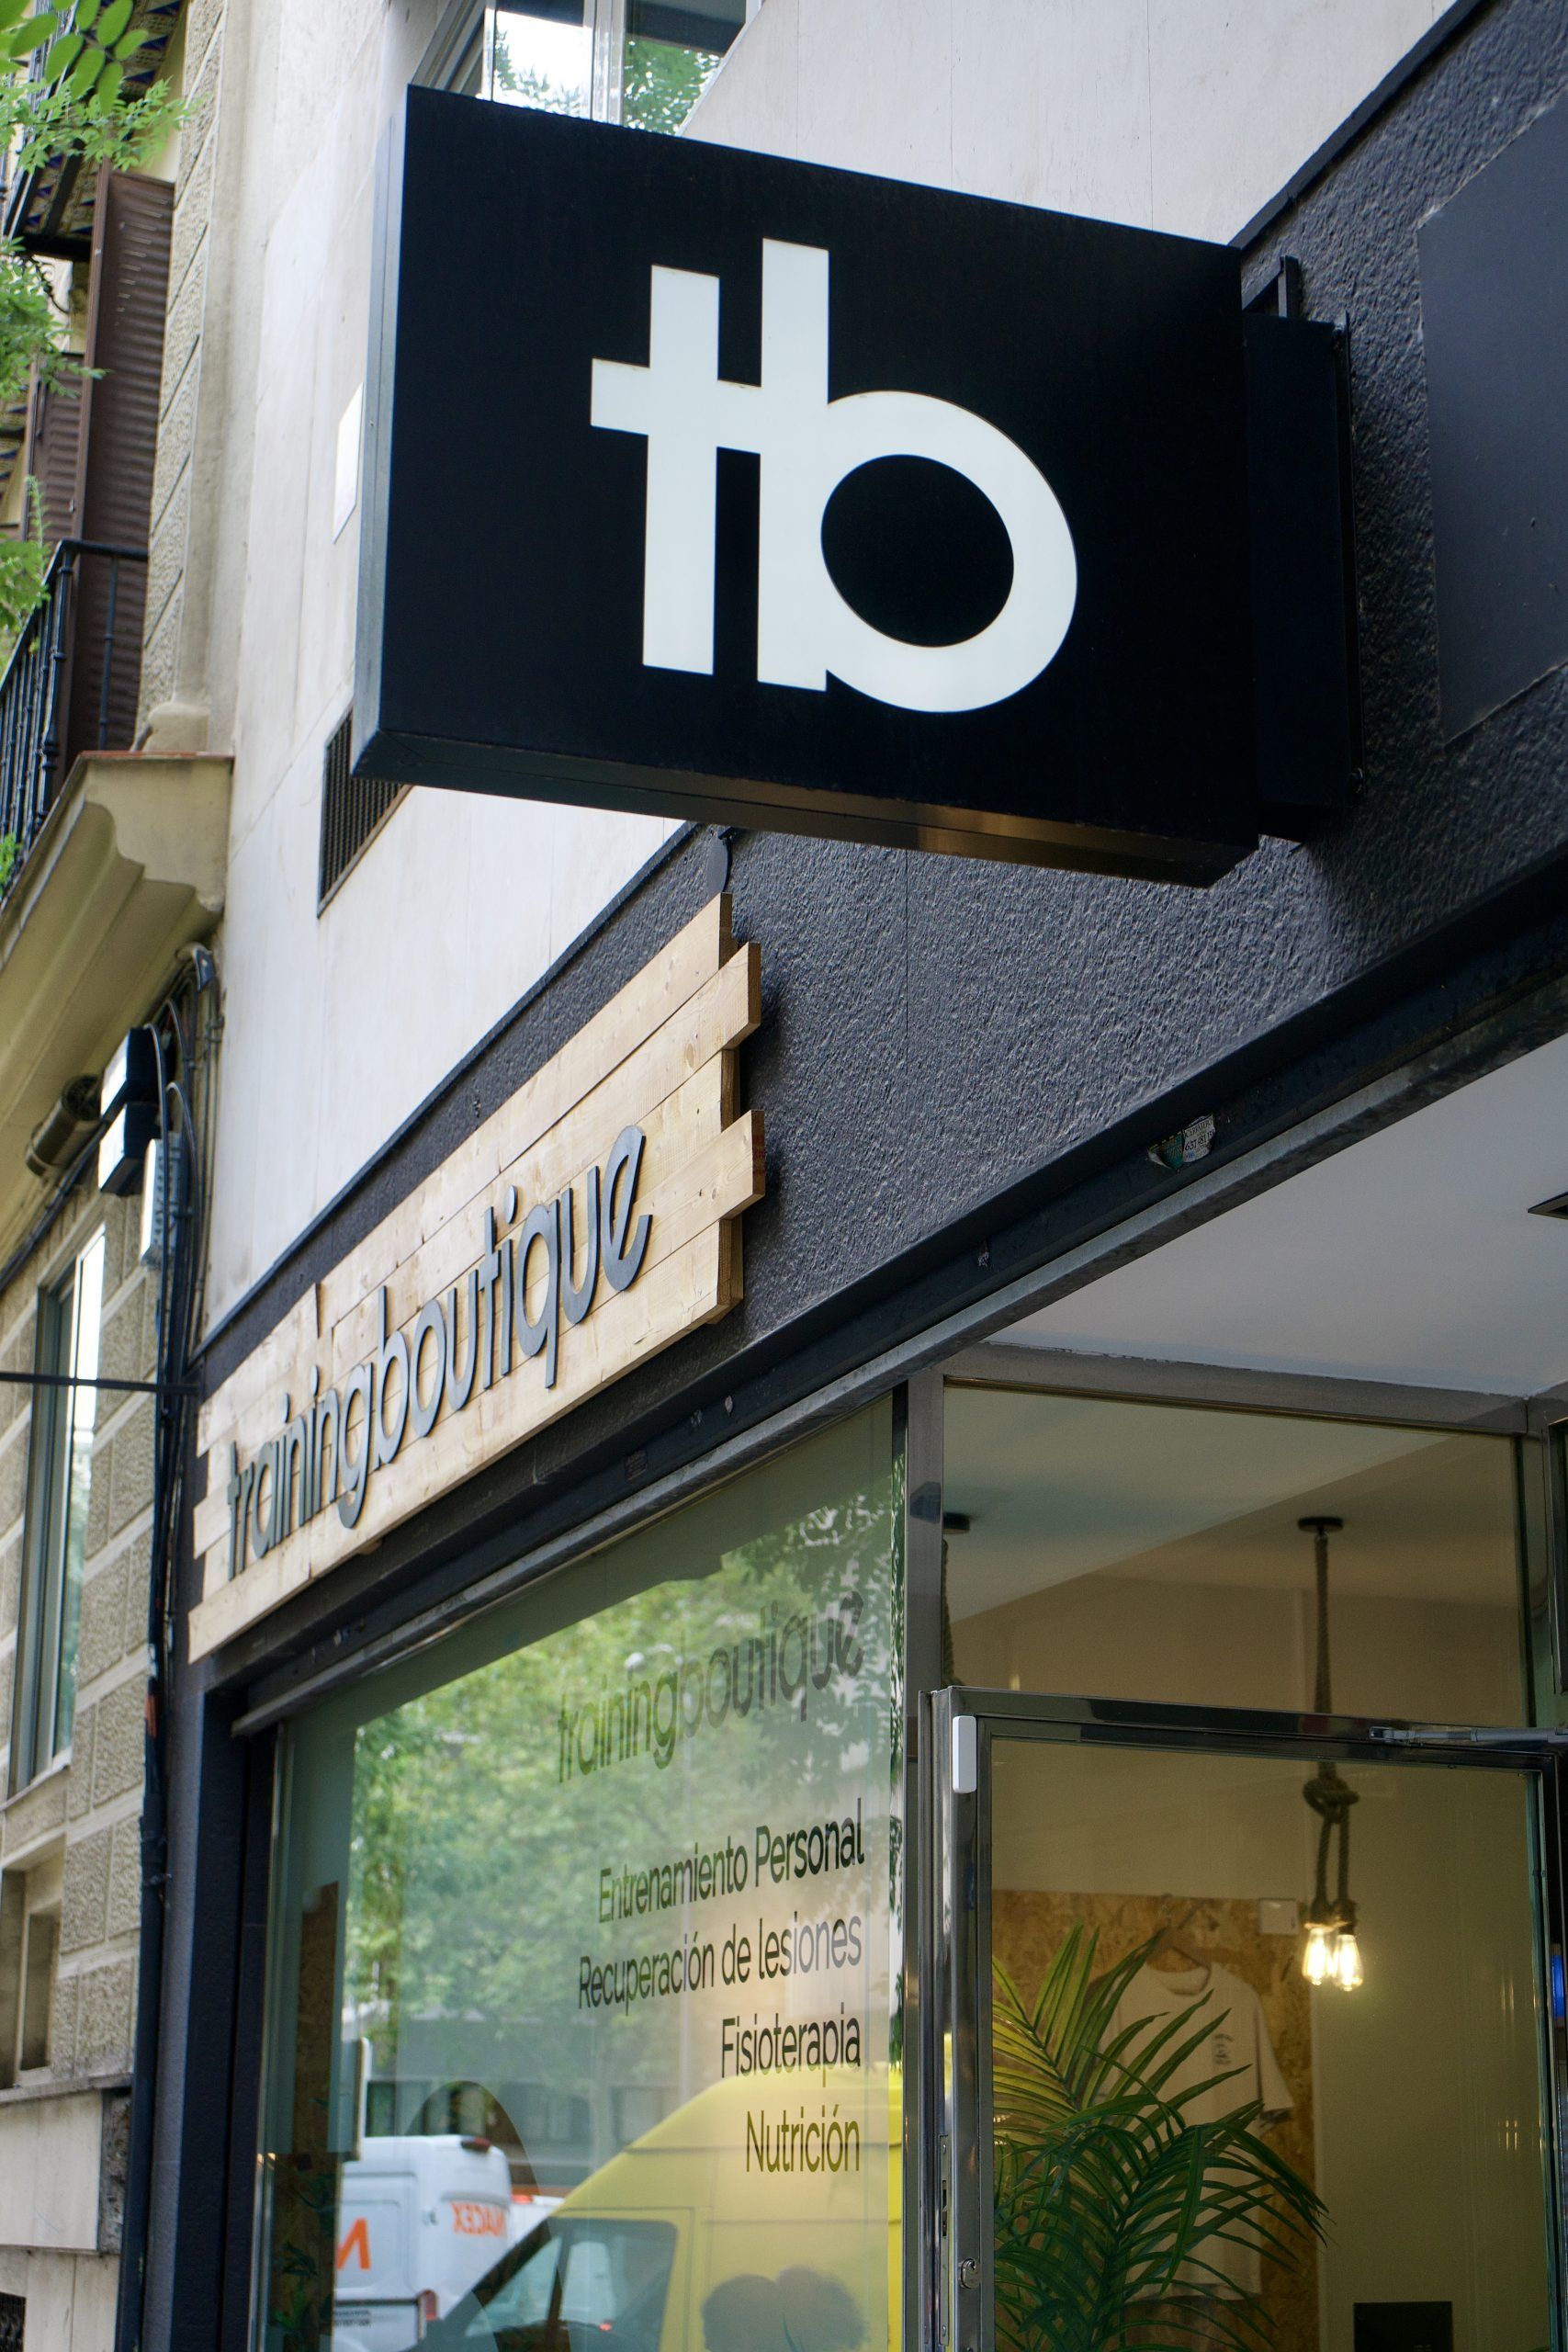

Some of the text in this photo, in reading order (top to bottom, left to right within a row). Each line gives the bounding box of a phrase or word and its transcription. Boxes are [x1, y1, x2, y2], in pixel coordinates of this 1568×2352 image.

[590, 236, 1078, 714] tb
[228, 1125, 653, 1582] trainingboutique
[558, 1590, 864, 1783] trainingboutique
[599, 1797, 865, 1923] Entrenamiento Personal
[579, 1911, 862, 2017] Recuperación de lesiones
[721, 2002, 862, 2088] Fisioterapia
[746, 2104, 860, 2173] Nutrición
